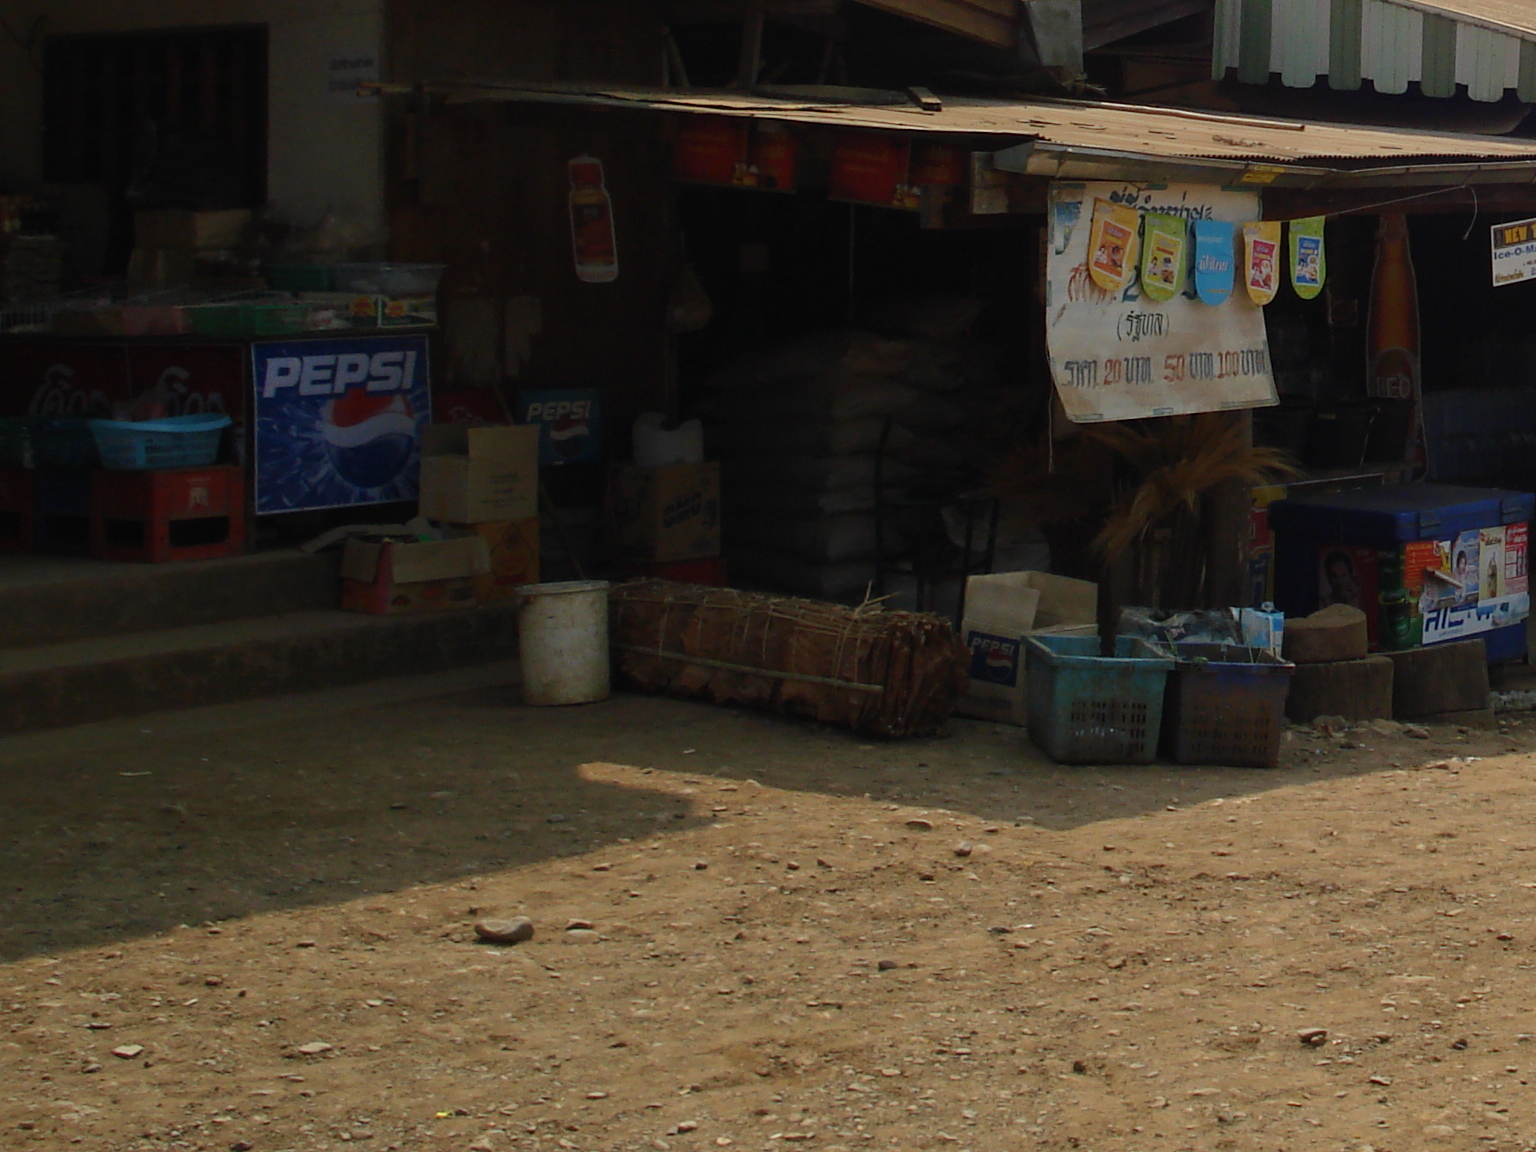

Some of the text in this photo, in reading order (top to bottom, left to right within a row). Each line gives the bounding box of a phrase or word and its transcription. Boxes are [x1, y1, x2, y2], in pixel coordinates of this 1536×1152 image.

[262, 350, 417, 398] PEPSI
[1104, 359, 1122, 385] 20
[1164, 353, 1186, 382] 50
[526, 400, 592, 422] PEPSI
[970, 636, 1015, 656] PEPSI
